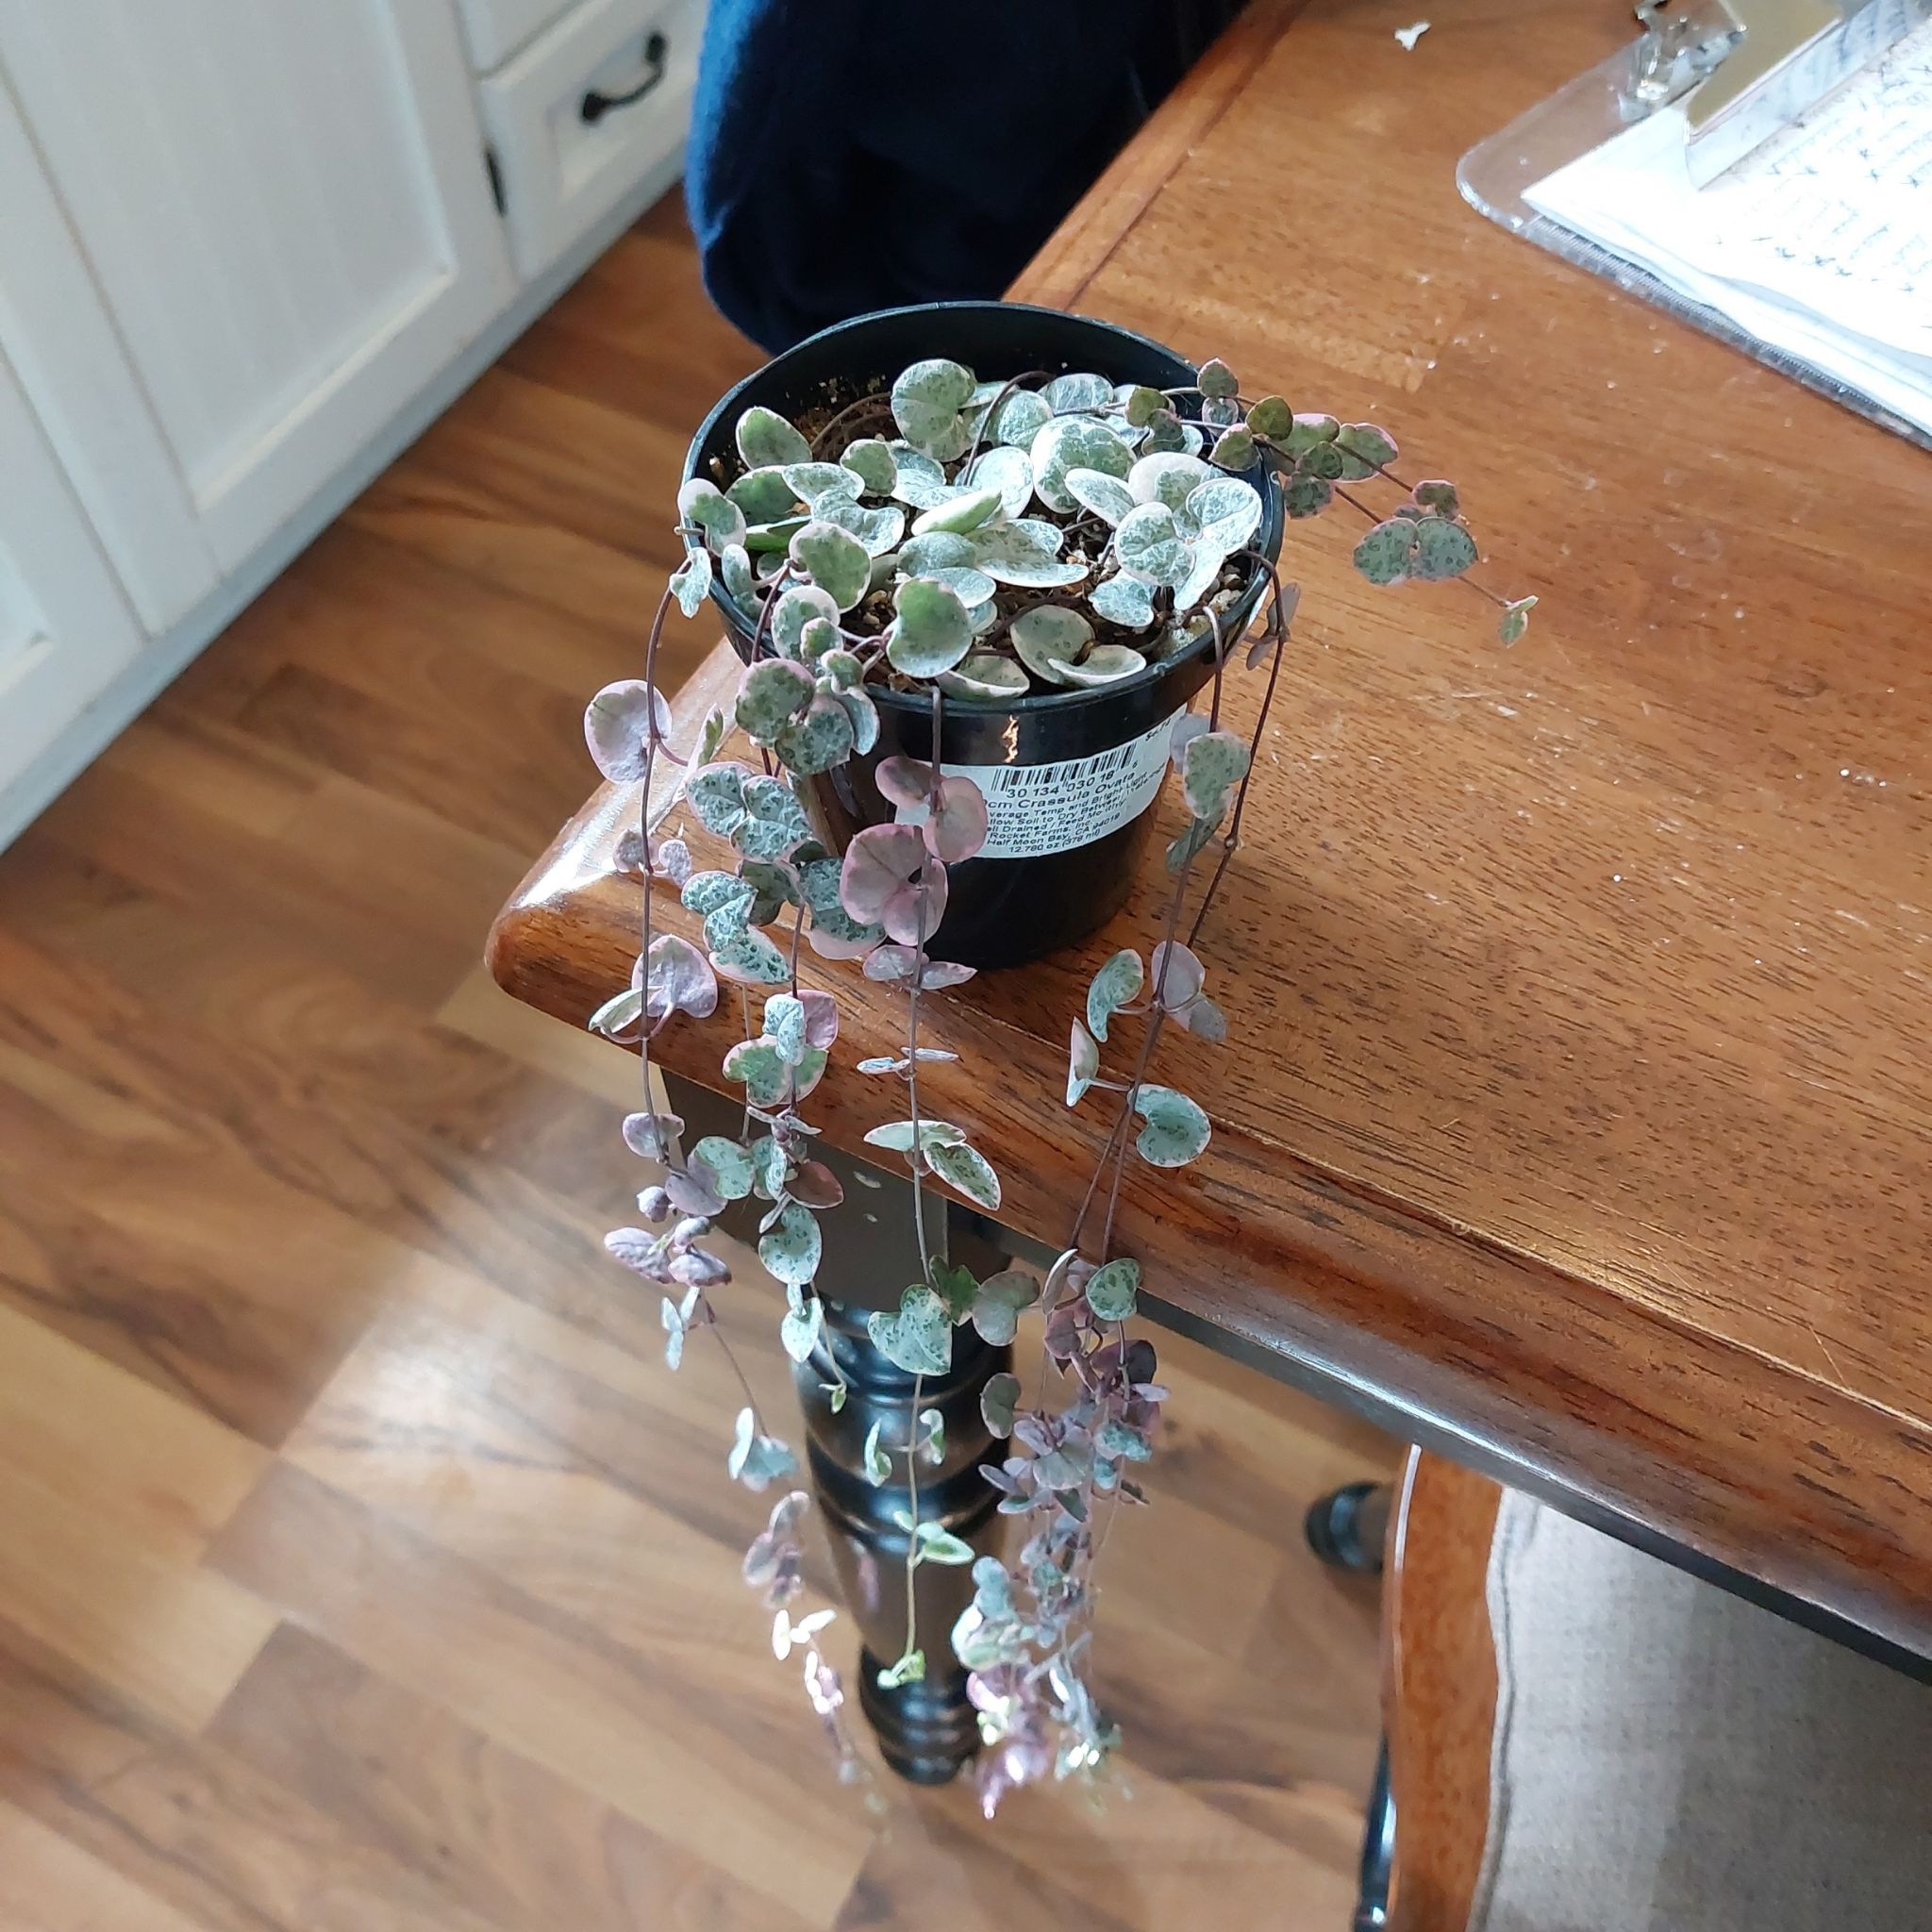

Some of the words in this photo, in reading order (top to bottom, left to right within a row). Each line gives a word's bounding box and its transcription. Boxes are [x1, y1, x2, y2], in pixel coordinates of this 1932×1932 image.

[984, 799, 1012, 808] cm
[1018, 791, 1090, 808] Crassula
[1095, 772, 1135, 794] Ovata
[1007, 789, 1027, 798] 30
[1033, 786, 1059, 797] 134
[1101, 770, 1115, 782] 18
[1034, 807, 1065, 817] Temp
[1068, 799, 1089, 811] and
[1091, 787, 1124, 804] Bright
[1002, 824, 1048, 833] Drained
[1058, 817, 1084, 827] Feed
[1017, 817, 1040, 825] Soil
[1058, 811, 1078, 821] Dry
[1013, 838, 1044, 846] Moon
[1075, 826, 1091, 836] CA
